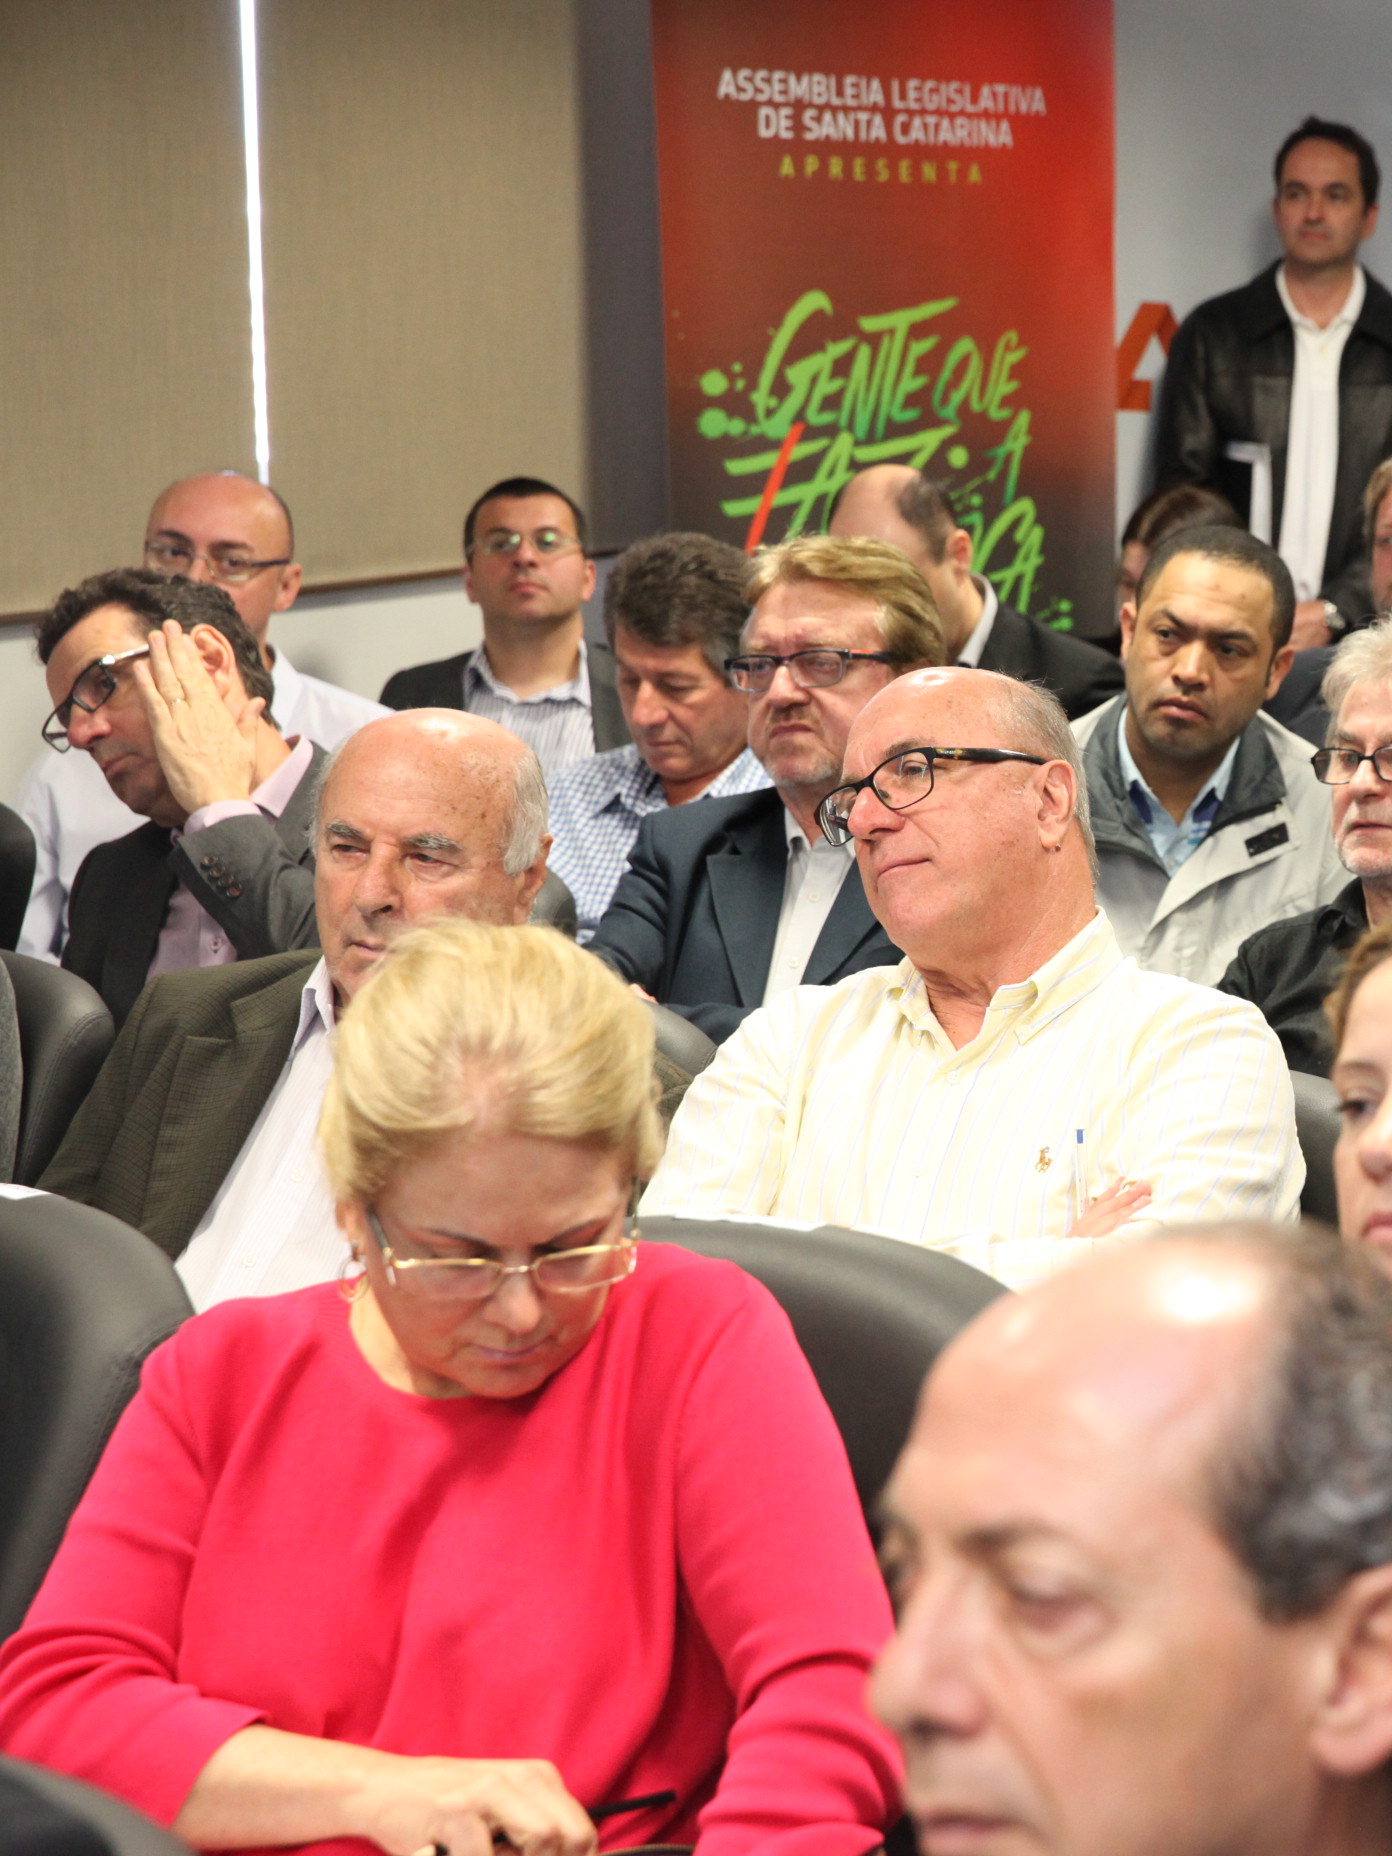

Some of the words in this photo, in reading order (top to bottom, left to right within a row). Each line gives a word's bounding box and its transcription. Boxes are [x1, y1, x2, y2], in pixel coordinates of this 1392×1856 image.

[717, 67, 886, 108] ASSEMBLEIA
[890, 78, 1047, 116] LEGISLATIVA
[757, 106, 794, 140] DE
[802, 108, 887, 144] SANTA
[893, 113, 1014, 149] CATARINA
[779, 154, 982, 184] APRESENTA
[751, 289, 959, 441] GENTE
